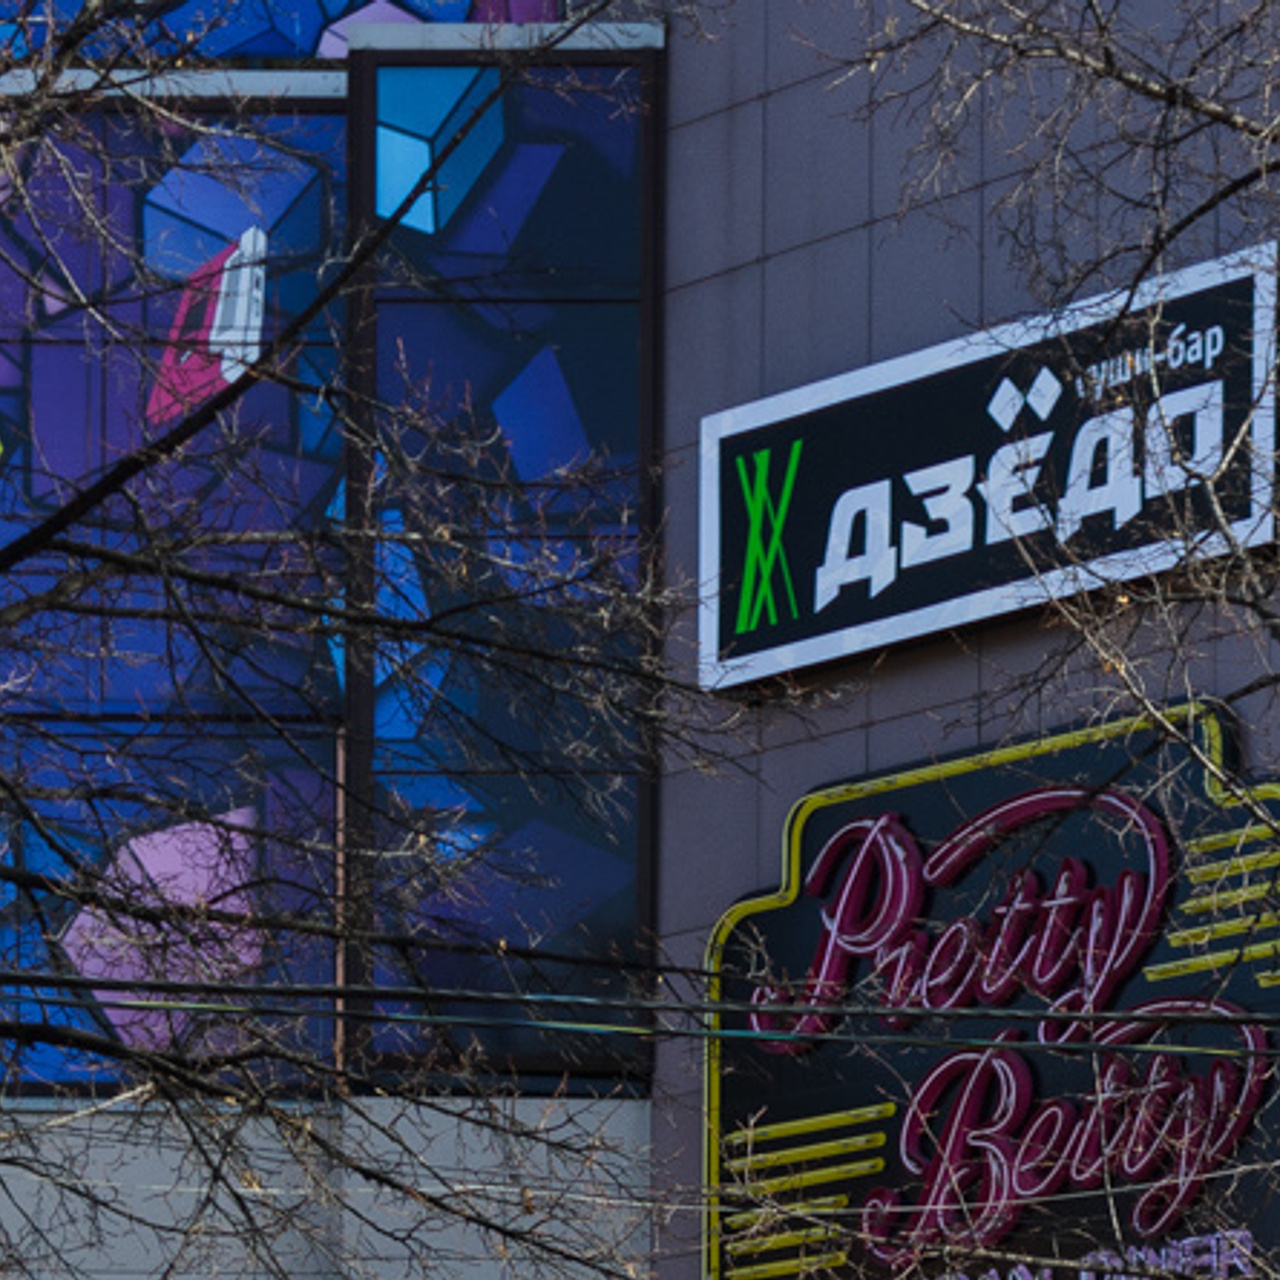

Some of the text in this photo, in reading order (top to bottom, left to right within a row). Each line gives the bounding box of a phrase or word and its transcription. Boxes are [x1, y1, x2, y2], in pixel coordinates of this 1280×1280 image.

[814, 366, 1224, 613] ДЗЁДО
[751, 787, 1172, 1053] Pretty
[862, 998, 1269, 1265] Betty
